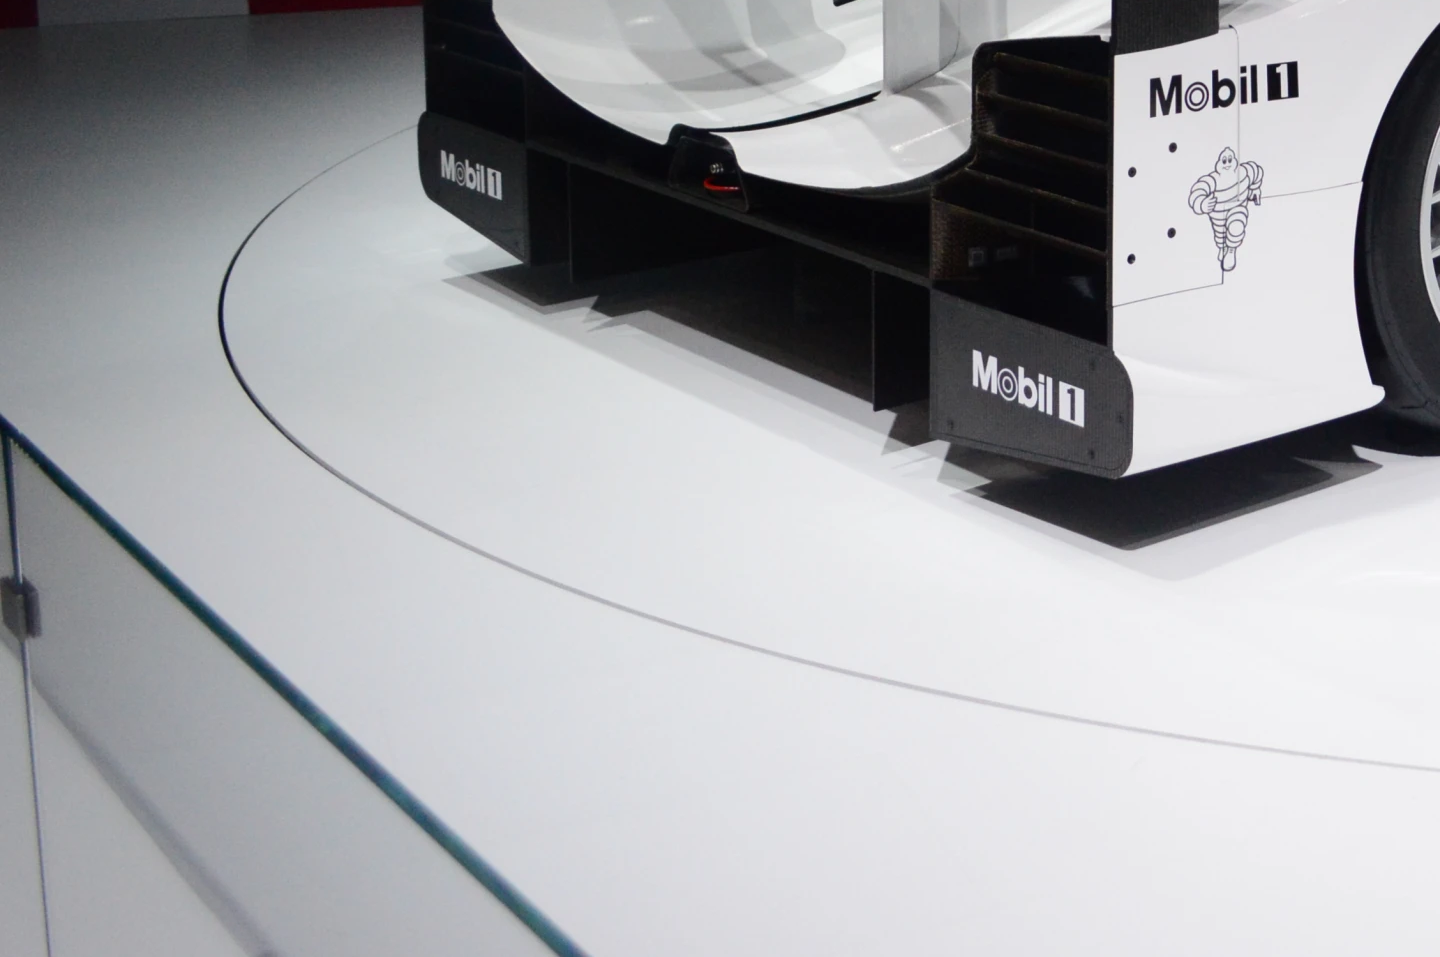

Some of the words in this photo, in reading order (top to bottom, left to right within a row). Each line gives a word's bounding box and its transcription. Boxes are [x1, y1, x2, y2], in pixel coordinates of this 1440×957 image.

[1149, 64, 1259, 119] Mobil
[440, 149, 486, 194] Mobil
[972, 348, 1053, 416] Mobil
